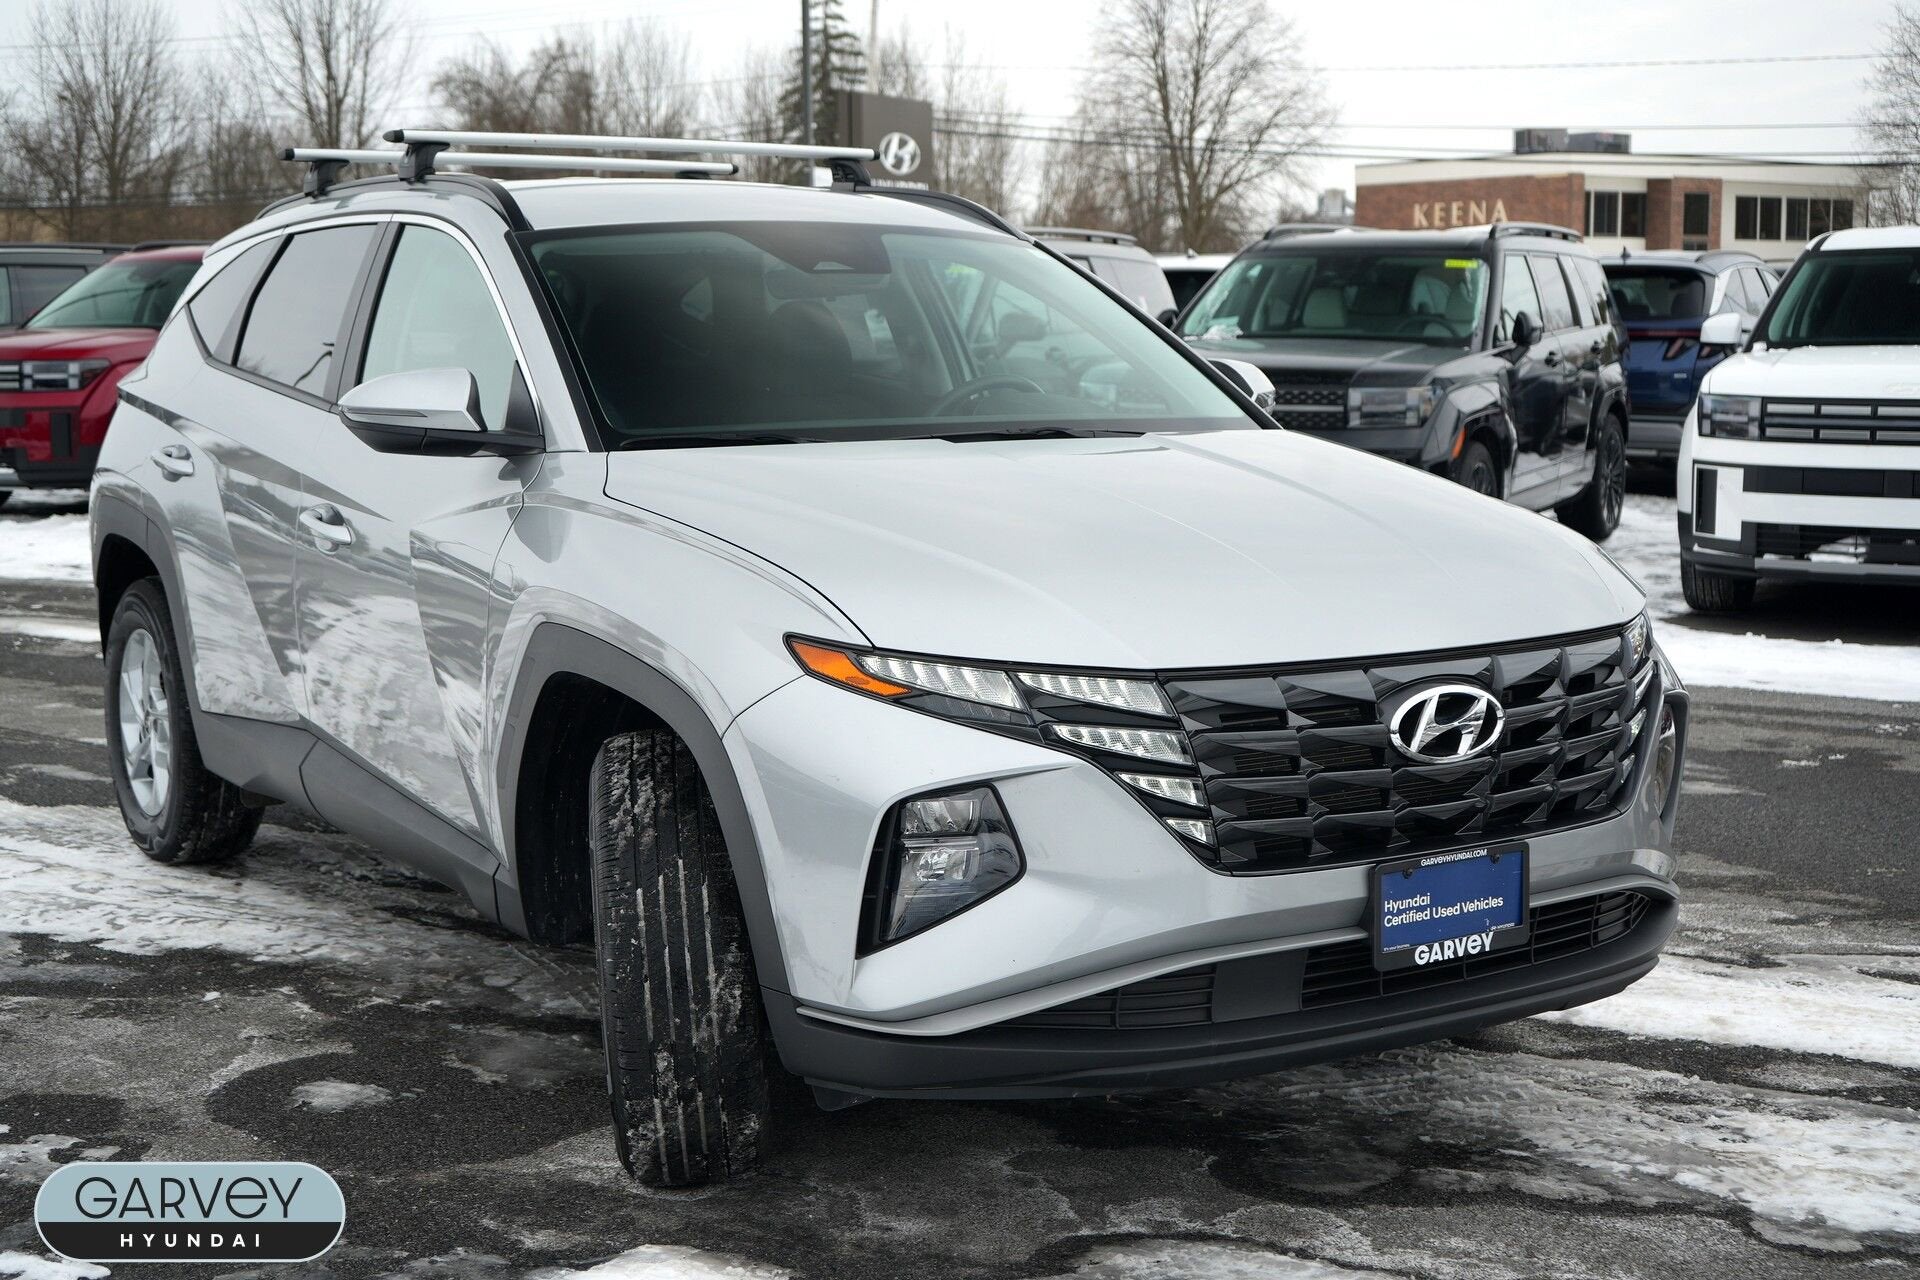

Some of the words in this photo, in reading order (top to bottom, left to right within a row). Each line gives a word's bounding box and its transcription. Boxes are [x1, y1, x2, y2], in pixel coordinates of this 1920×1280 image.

[1413, 198, 1509, 228] KEENA
[1384, 892, 1431, 913] Hyundai
[1384, 907, 1431, 928] Certified
[1432, 901, 1460, 919] Used
[1462, 896, 1504, 914] Vehicles
